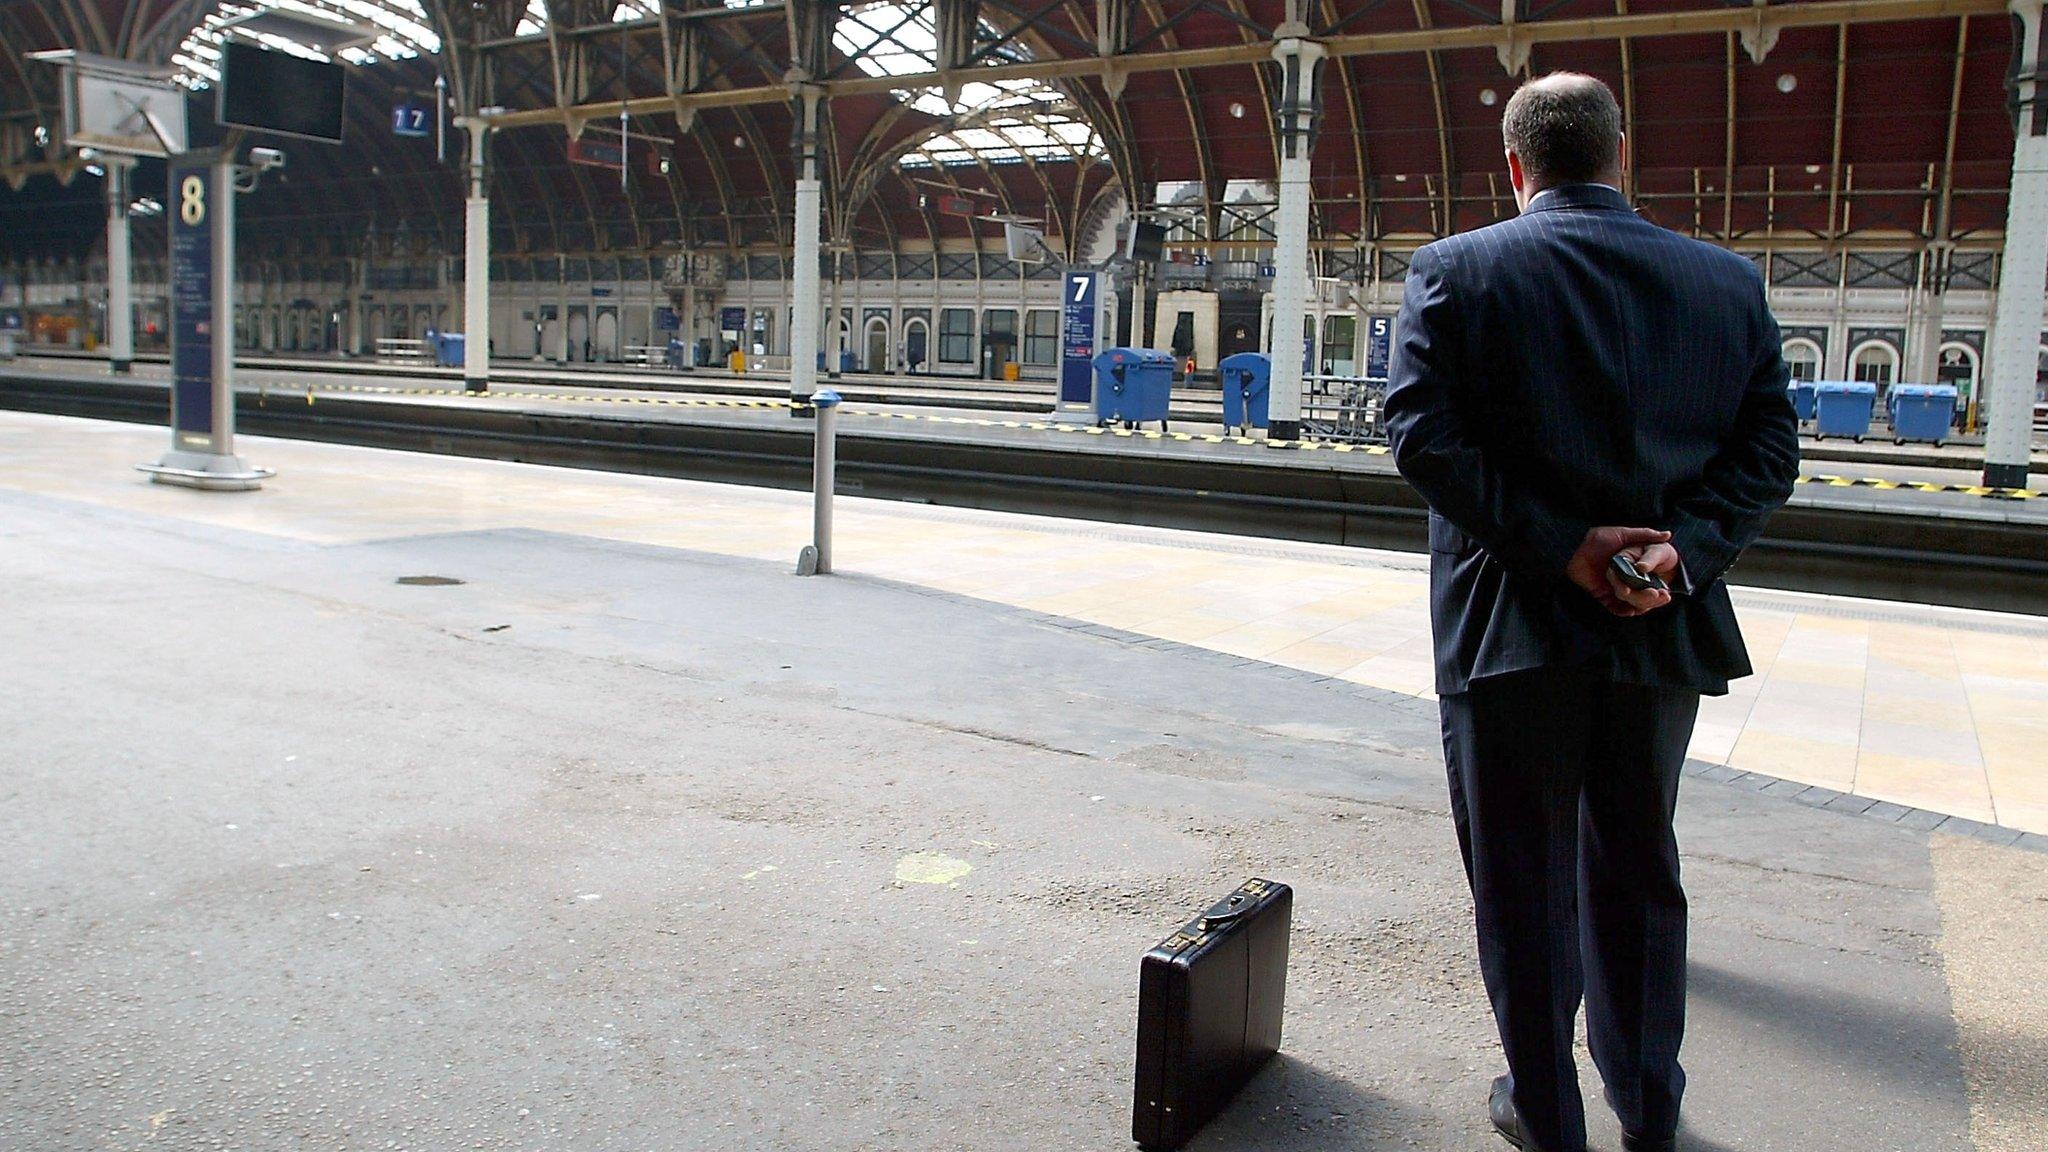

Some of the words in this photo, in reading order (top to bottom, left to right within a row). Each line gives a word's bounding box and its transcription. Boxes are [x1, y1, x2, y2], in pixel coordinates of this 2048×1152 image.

[411, 110, 424, 128] 7
[181, 174, 206, 227] 8
[1072, 276, 1090, 302] 7
[1374, 319, 1387, 336] 5
